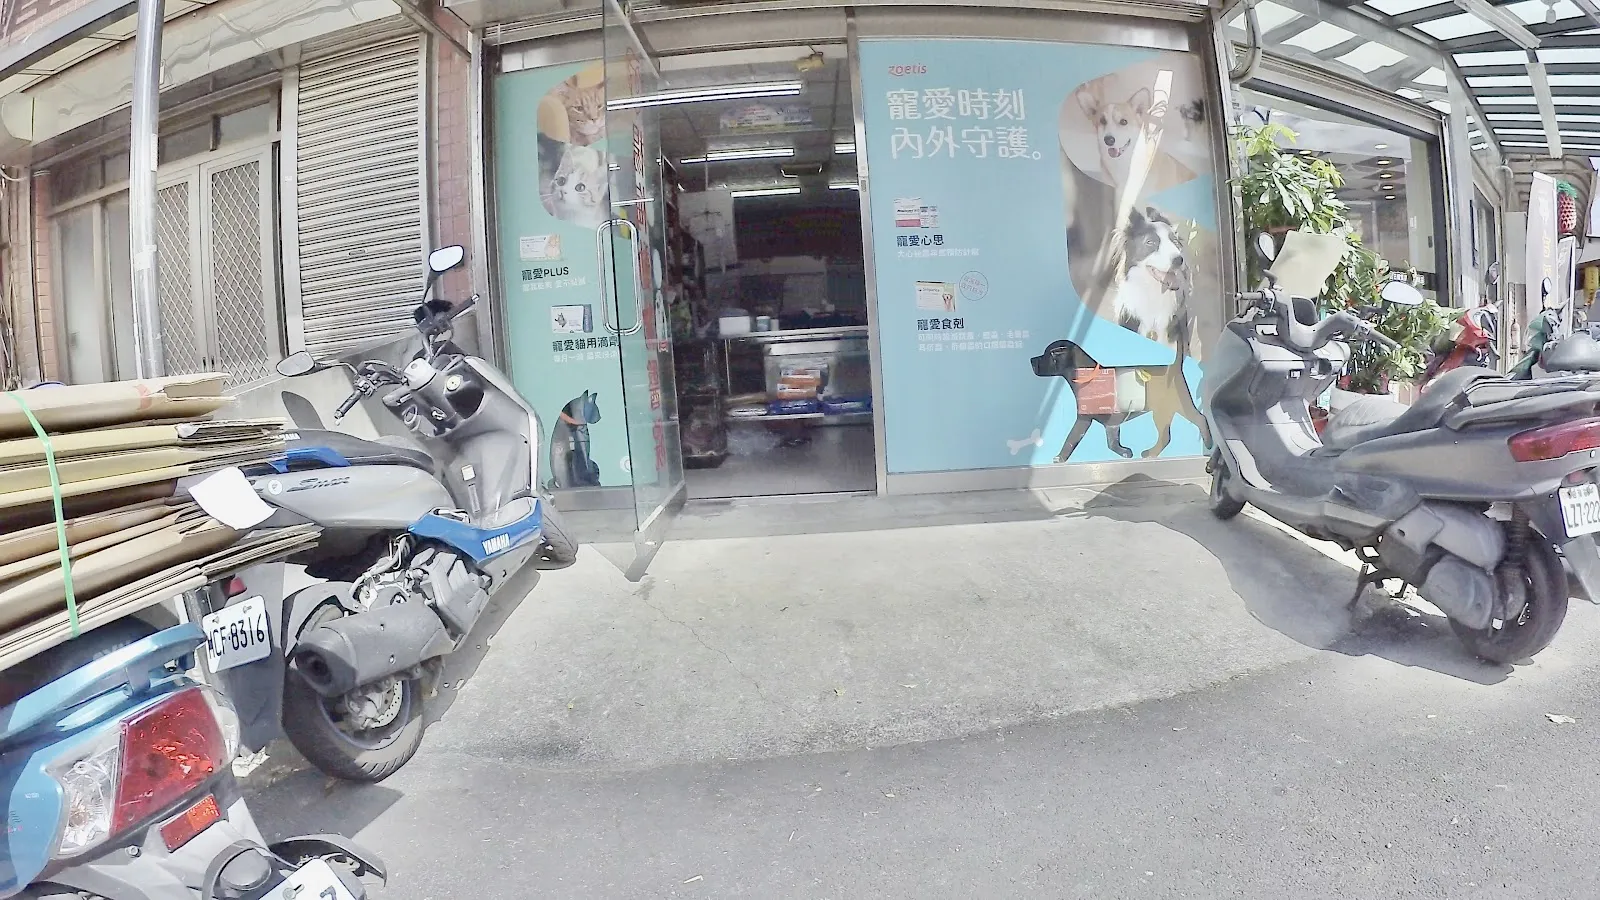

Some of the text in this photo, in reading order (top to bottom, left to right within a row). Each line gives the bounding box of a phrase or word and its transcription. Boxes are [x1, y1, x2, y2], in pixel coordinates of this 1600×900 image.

[888, 62, 927, 76] zoetis
[886, 87, 1026, 121] 寵愛時刻
[896, 234, 945, 247] 寵愛心思
[521, 266, 569, 281] 寵愛PLUS
[917, 317, 965, 331] 寵愛食剋
[481, 532, 510, 556] YAMAHA
